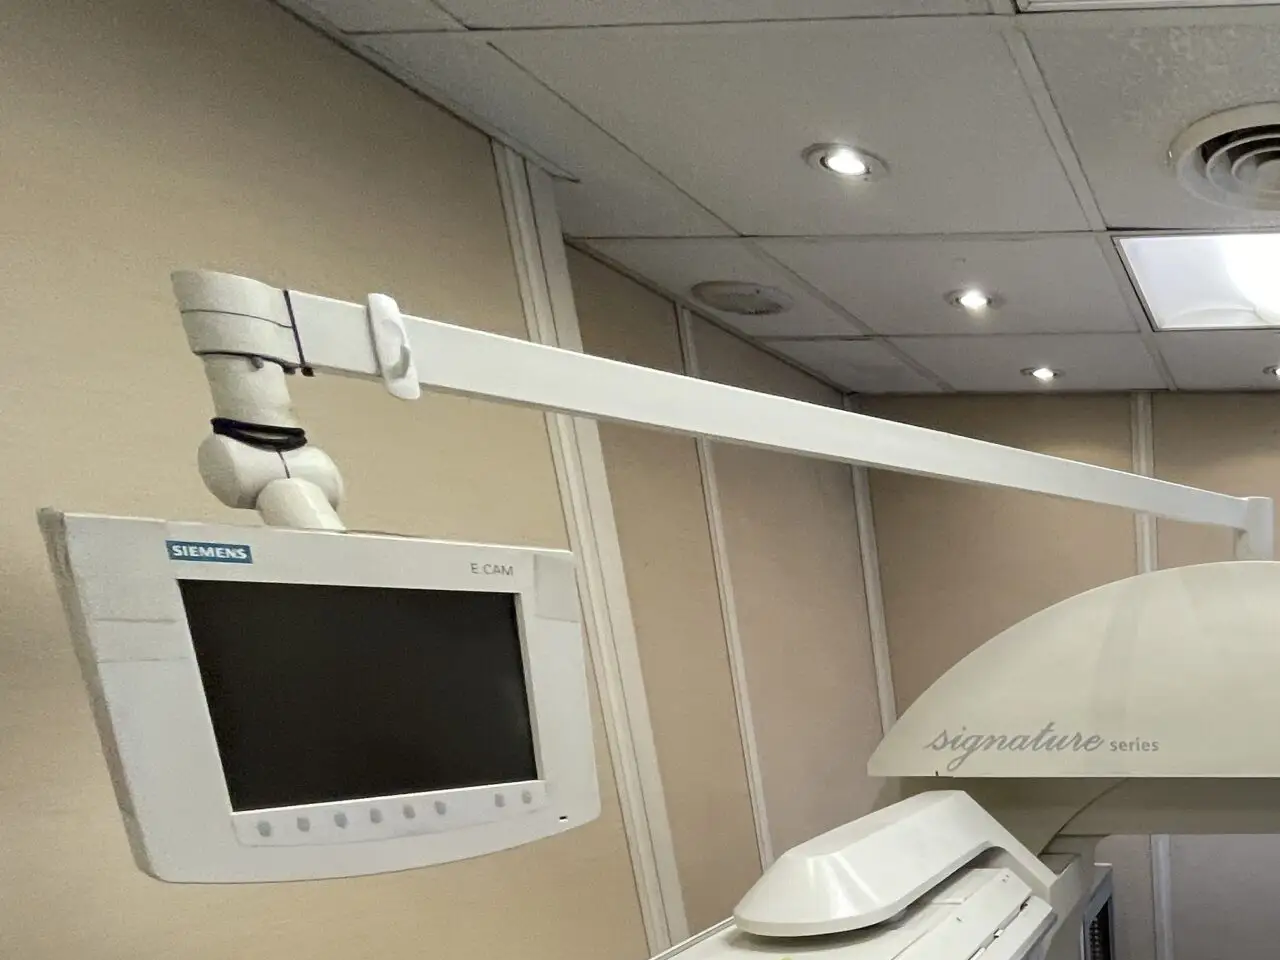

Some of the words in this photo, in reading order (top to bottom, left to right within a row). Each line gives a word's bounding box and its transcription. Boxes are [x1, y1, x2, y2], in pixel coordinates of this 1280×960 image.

[171, 544, 248, 559] SIEMENS
[924, 721, 1104, 772] signature
[1109, 736, 1160, 752] series
